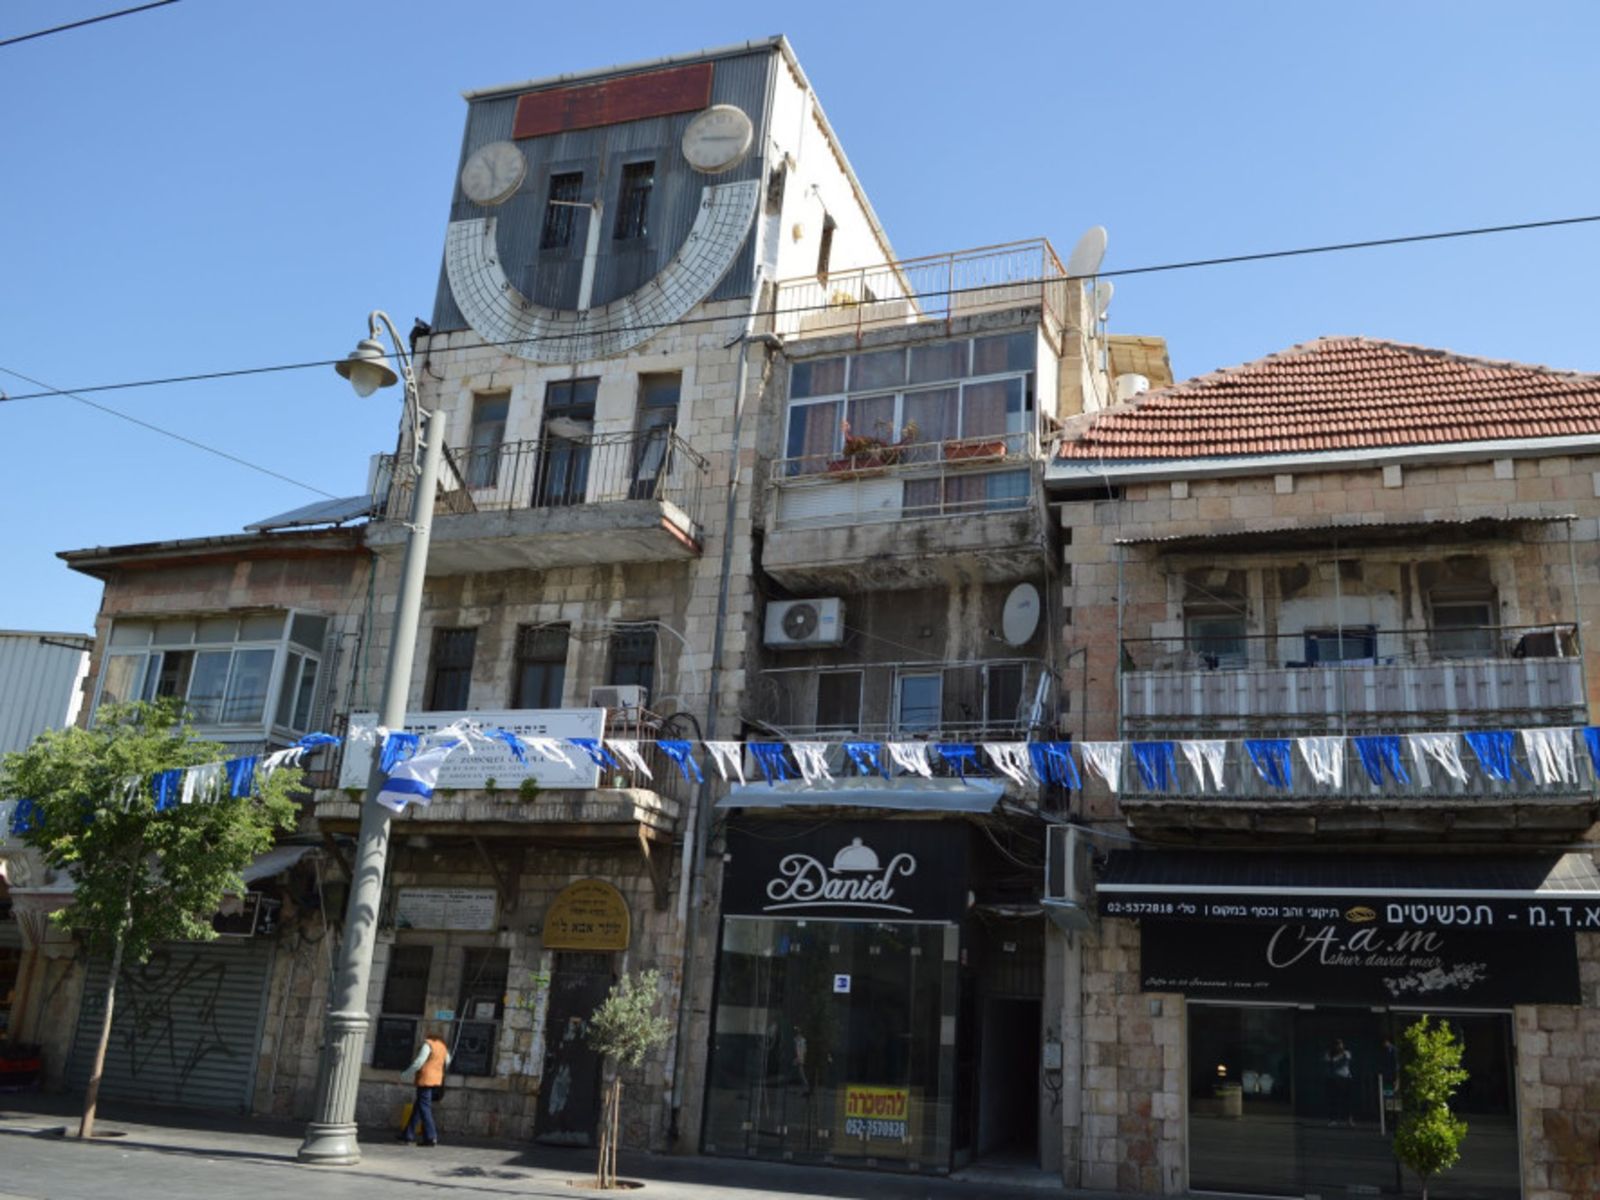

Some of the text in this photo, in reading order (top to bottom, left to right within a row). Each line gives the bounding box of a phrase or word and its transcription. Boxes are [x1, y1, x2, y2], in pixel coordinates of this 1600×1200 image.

[766, 852, 917, 901] Daniel
[1107, 901, 1174, 914] 02-5372818
[1211, 904, 1247, 917] במקום
[1250, 906, 1279, 918] וכסף
[1281, 906, 1304, 918] זהב
[1386, 903, 1494, 925] תכשיטים
[1364, 953, 1407, 967] david
[847, 1090, 906, 1116] להשכרה
